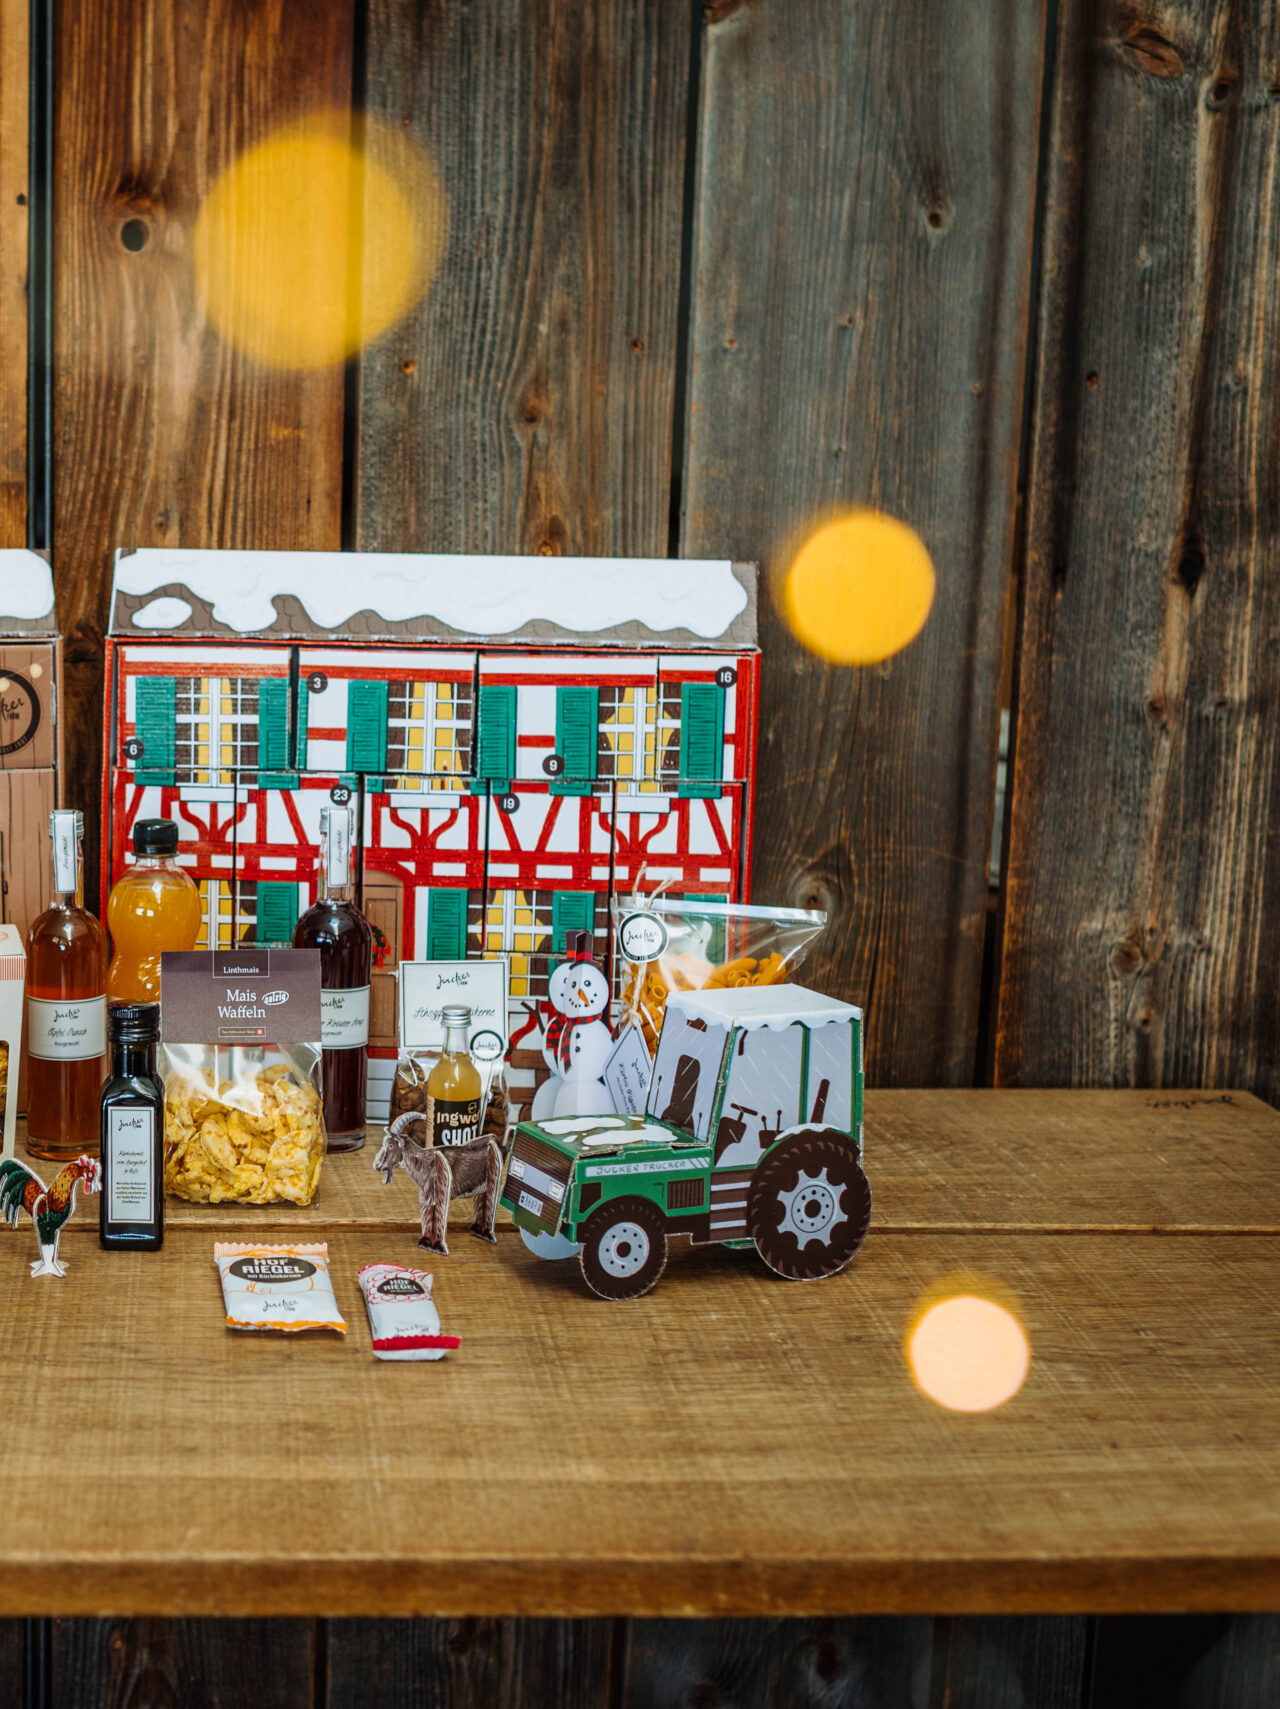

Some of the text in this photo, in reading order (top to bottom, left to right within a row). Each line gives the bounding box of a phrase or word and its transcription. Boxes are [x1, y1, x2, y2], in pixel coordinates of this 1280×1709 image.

[313, 677, 322, 689] 3
[720, 671, 732, 683] 16
[129, 744, 138, 755] 6
[548, 760, 557, 771] 9
[333, 789, 348, 801] 23
[502, 797, 515, 809] 19
[223, 966, 260, 974] Linthmais
[437, 972, 470, 989] Jucker
[226, 989, 257, 1002] Mais
[320, 997, 345, 1010] ucker
[53, 1009, 80, 1022] Jucker
[217, 1005, 267, 1019] Waffeln
[118, 1118, 143, 1131] Jucker
[437, 1110, 480, 1127] Ingwe
[442, 1124, 477, 1146] SHOT
[596, 1160, 686, 1175] JUCKER TRUCKER
[254, 1258, 288, 1266] HOF
[242, 1265, 305, 1274] RIEGEL
[262, 1298, 298, 1312] Jucker
